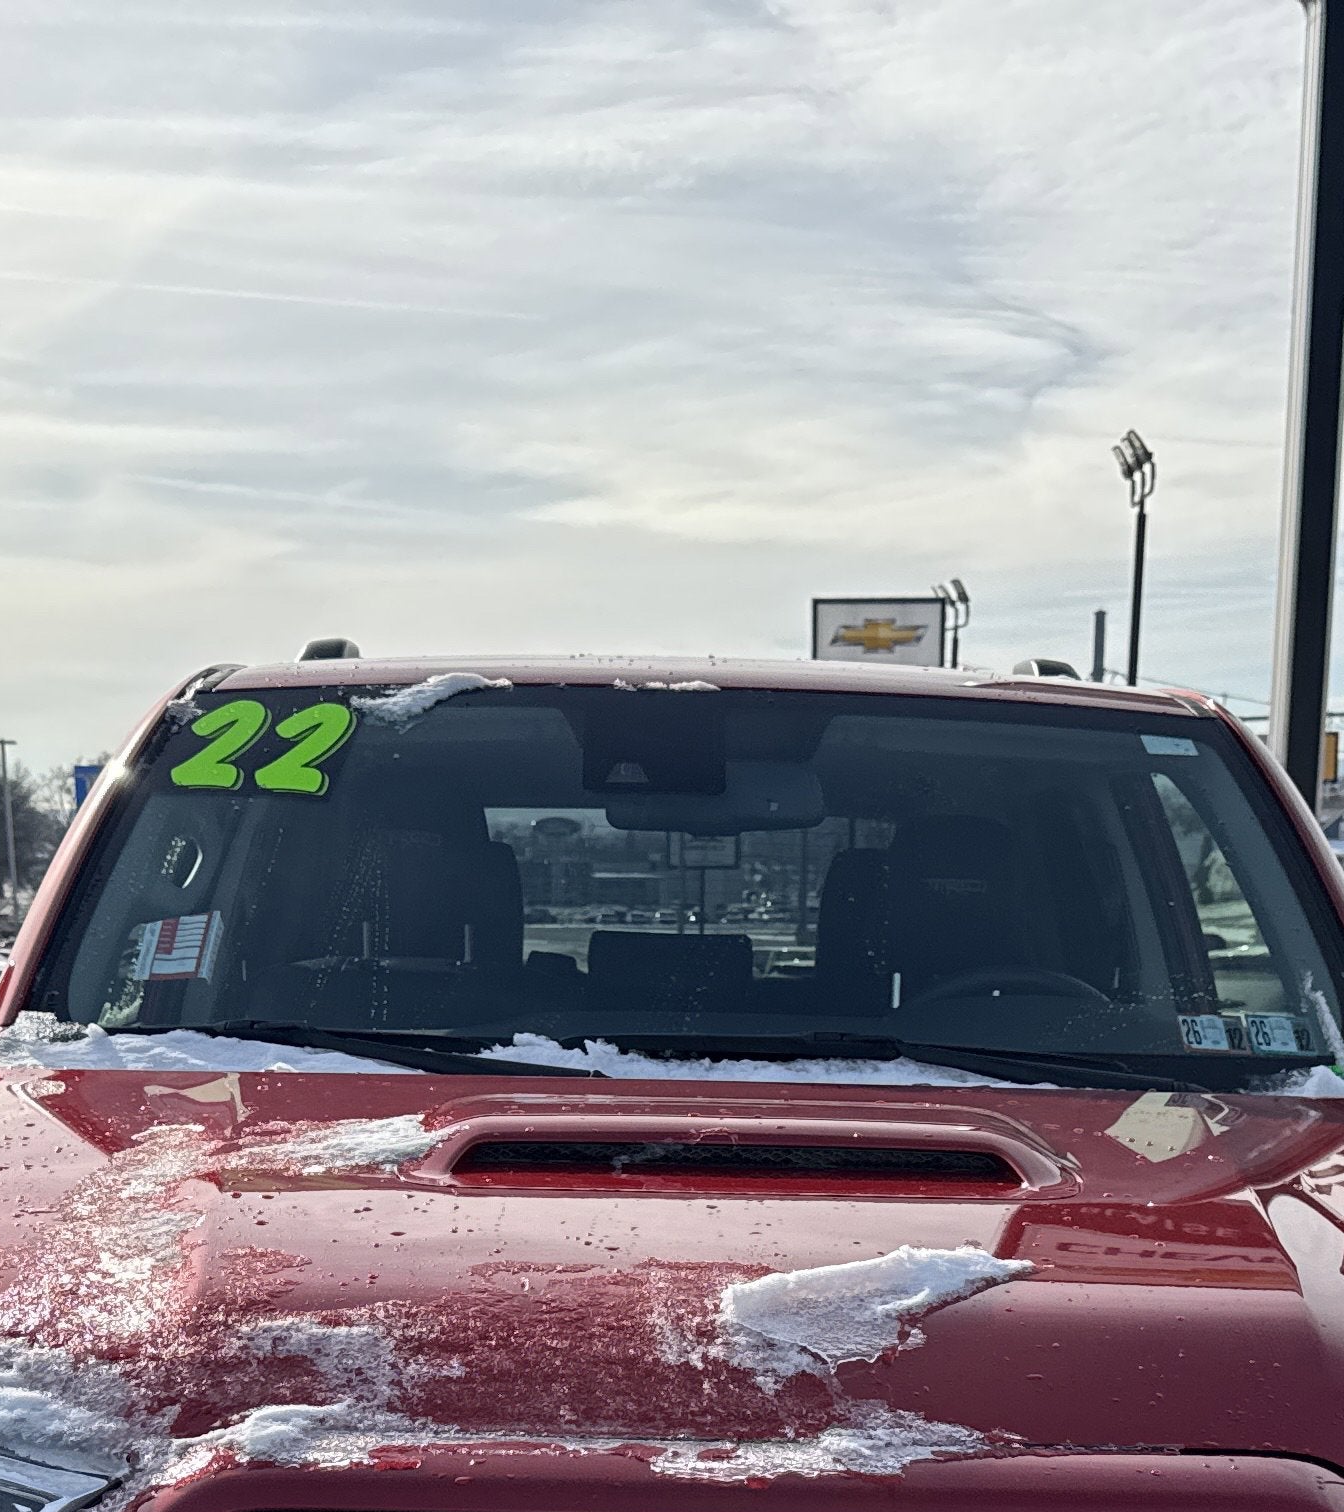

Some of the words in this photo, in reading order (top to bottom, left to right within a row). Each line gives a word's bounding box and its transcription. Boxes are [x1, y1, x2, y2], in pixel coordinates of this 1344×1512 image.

[171, 700, 357, 796] 22
[1181, 1018, 1203, 1045] 26
[1251, 1019, 1272, 1047] 26
